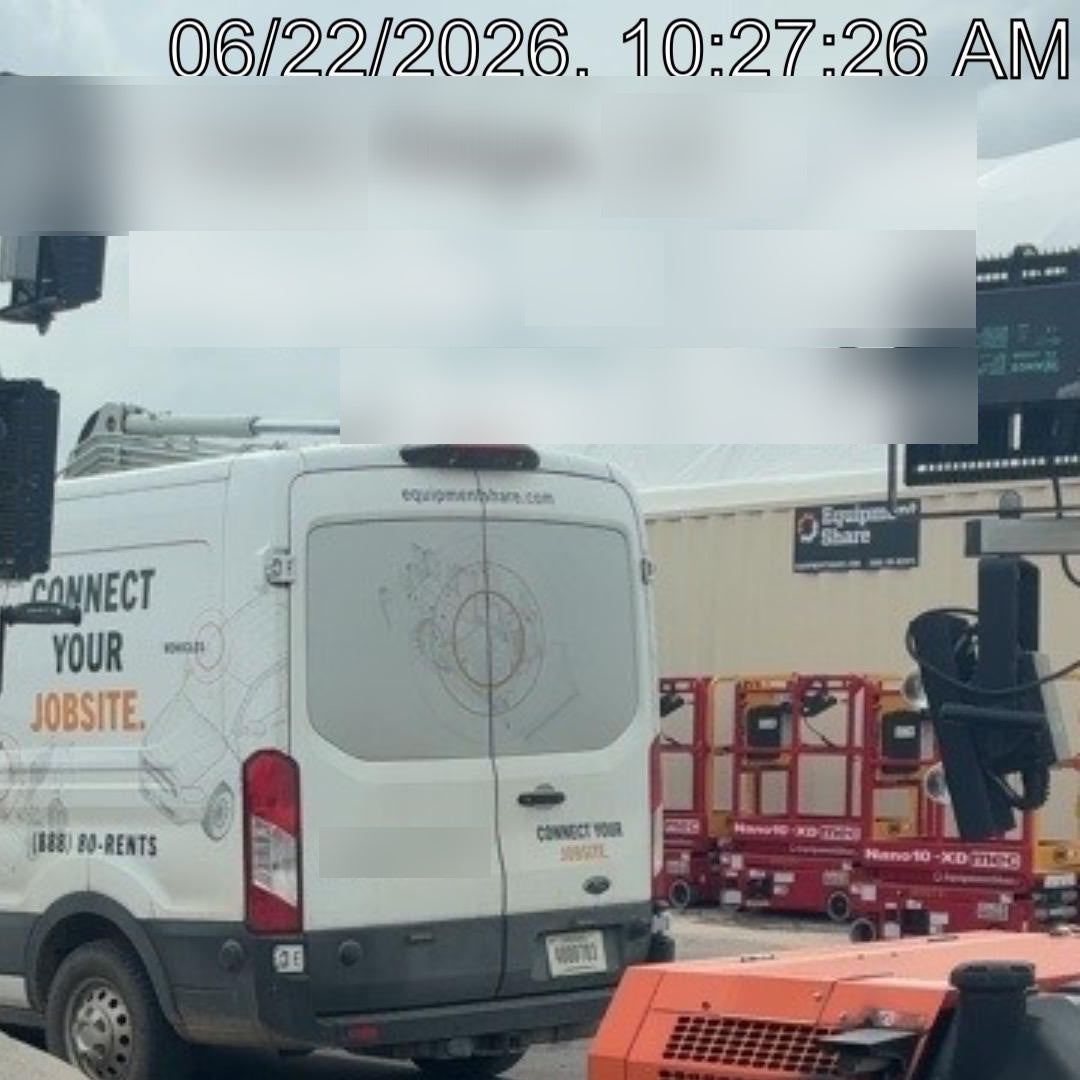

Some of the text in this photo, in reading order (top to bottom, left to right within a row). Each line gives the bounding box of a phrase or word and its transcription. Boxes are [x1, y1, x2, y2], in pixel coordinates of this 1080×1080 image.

[821, 528, 871, 547] Share
[31, 568, 157, 613] CONNECT
[53, 630, 124, 674] YOUR
[30, 689, 146, 732] JOBSITE.
[32, 831, 157, 856] (888) 80-RENTS
[536, 821, 623, 841] CONNECT YOUR
